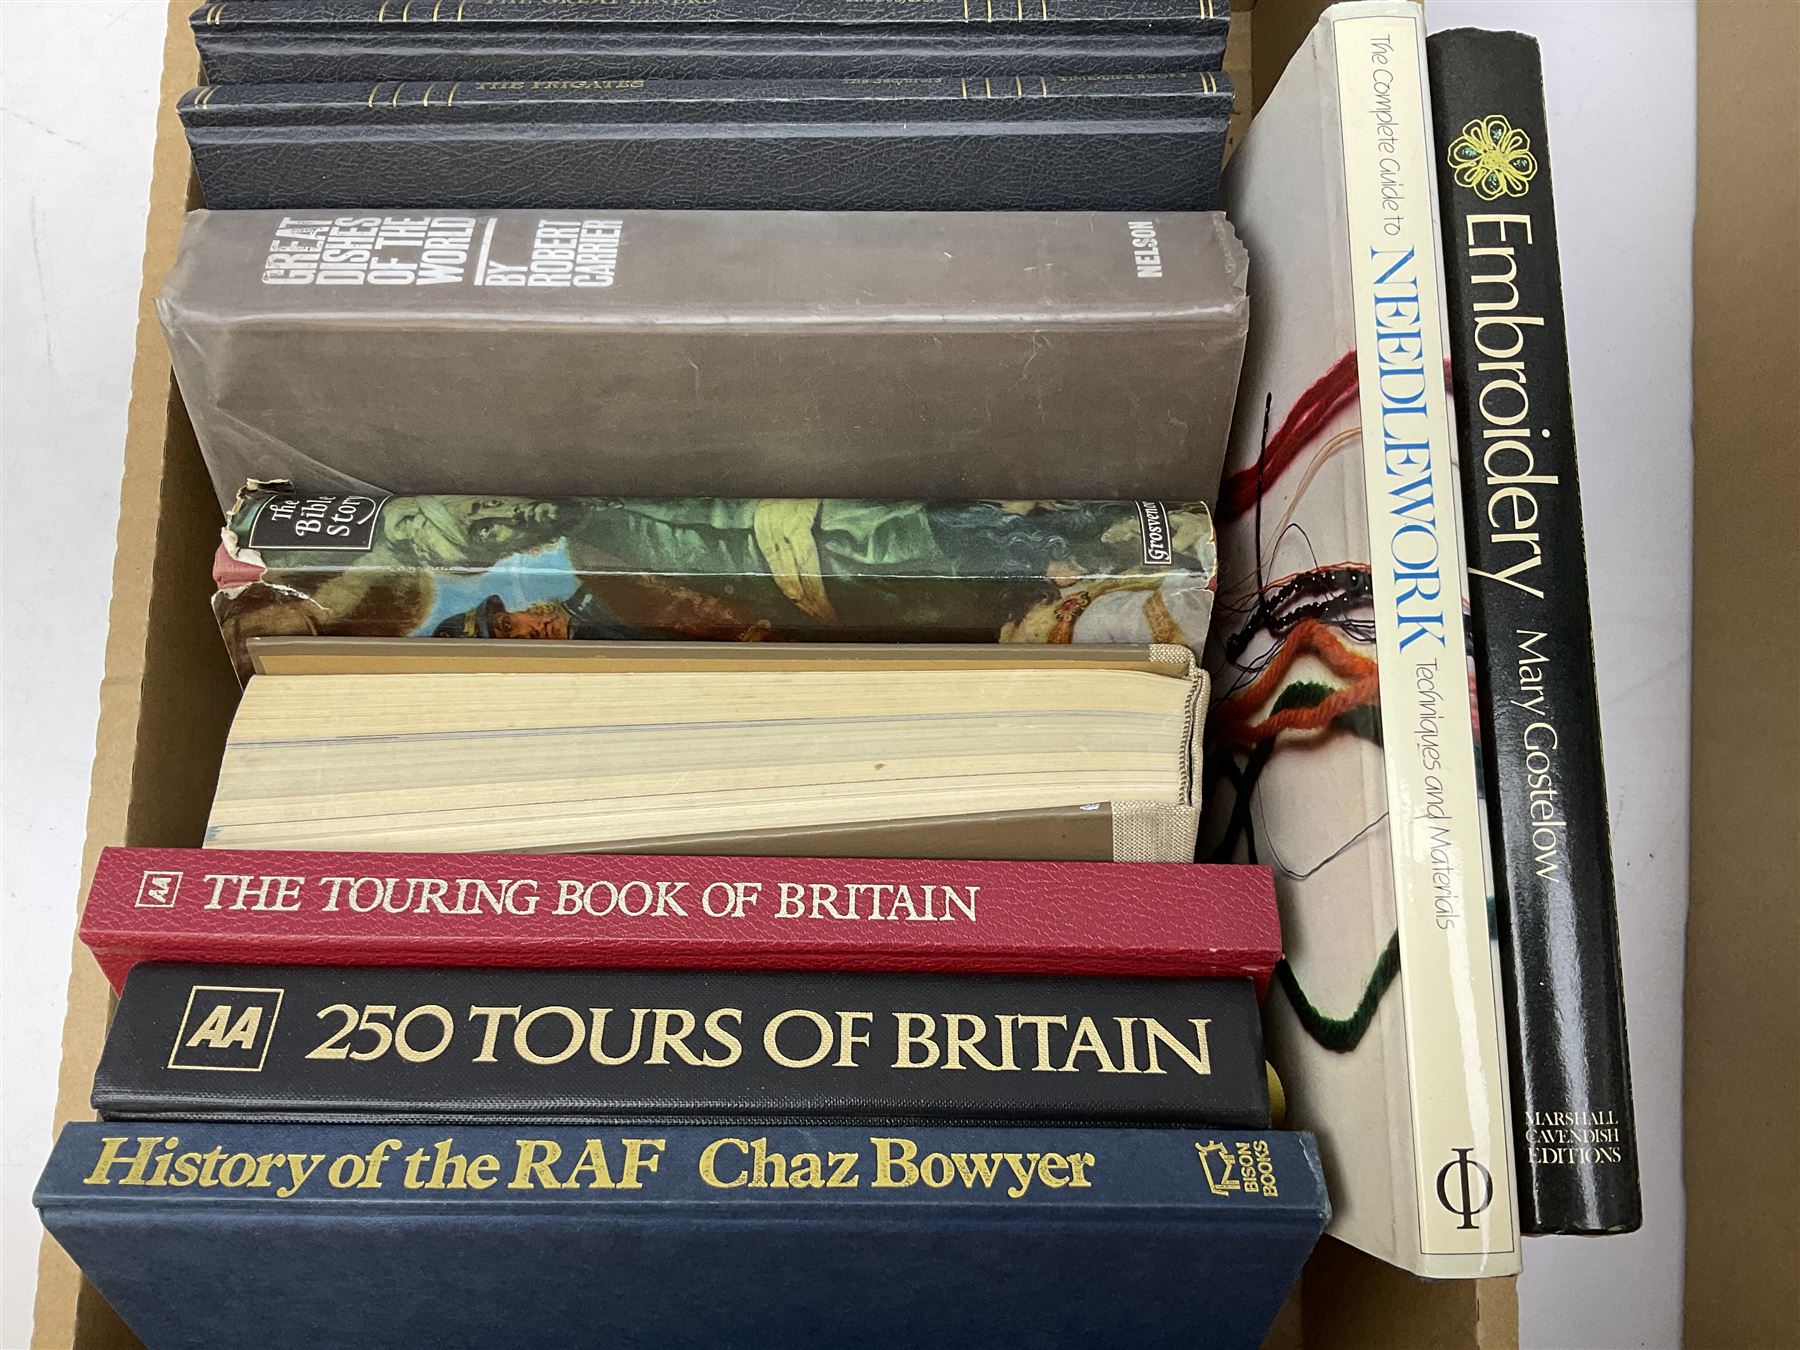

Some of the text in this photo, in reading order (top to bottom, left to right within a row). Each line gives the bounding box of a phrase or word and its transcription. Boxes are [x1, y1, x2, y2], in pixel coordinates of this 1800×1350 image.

[261, 216, 334, 286] GREAT
[315, 216, 383, 286] DISHES
[366, 216, 432, 286] OF THE
[415, 216, 477, 286] WORLD
[485, 261, 529, 286] BY
[527, 219, 583, 287] ROBERT
[572, 220, 624, 288] CARRIER
[1127, 221, 1163, 278] NELSON
[1369, 34, 1460, 930] The Complete Guide to NEEDLEWORK Techniques and Materials
[269, 500, 301, 522] The
[295, 495, 337, 538] Bible
[326, 495, 377, 537] Story
[1465, 214, 1568, 884] Embroidery Mary Gostelow
[202, 873, 982, 922] THE TOURING BOOK OF BRITAIN
[185, 1004, 266, 1050] AA
[304, 1003, 1213, 1076] 250 TOURS OF BRITAIN
[1525, 1110, 1619, 1126] MARSHALL
[1525, 1128, 1620, 1144] CAVENDISH
[83, 1136, 1097, 1199] History of the RAF Chaz Bowyer
[1235, 1142, 1260, 1193] BISON
[1252, 1140, 1279, 1197] BOOKS
[1527, 1146, 1622, 1164] EDITIONS
